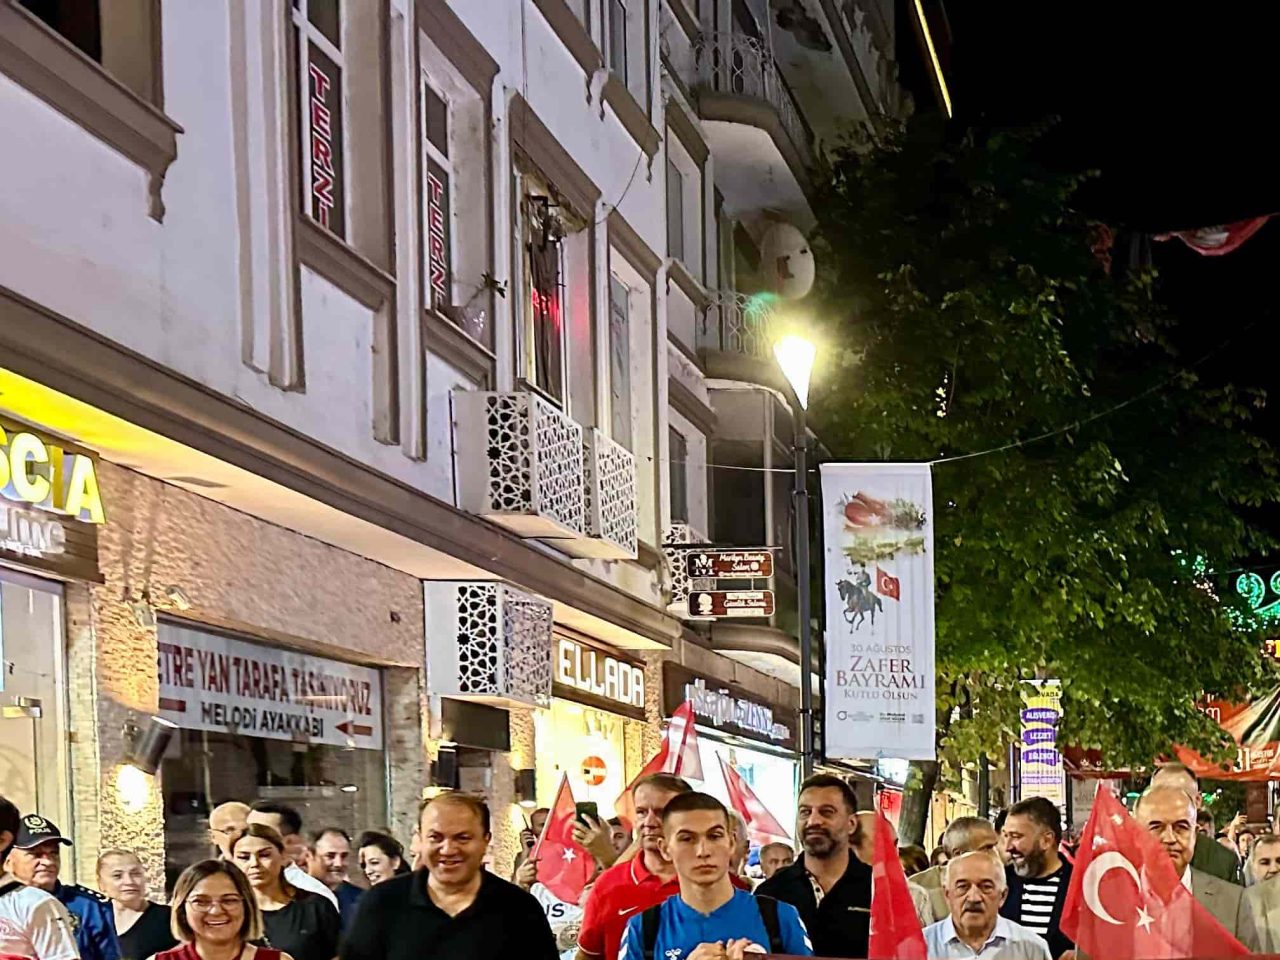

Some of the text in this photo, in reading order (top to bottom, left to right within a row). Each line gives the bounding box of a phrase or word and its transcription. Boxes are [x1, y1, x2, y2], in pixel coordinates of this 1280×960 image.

[198, 650, 231, 694] YAN
[232, 657, 290, 703] TARAFA
[558, 638, 646, 708] ELLADA
[850, 655, 914, 673] ZAFER
[836, 670, 925, 689] BAYRAMI
[843, 689, 918, 700] KUTLU OLSUN
[201, 701, 324, 738] MELODİ AYAKKABI
